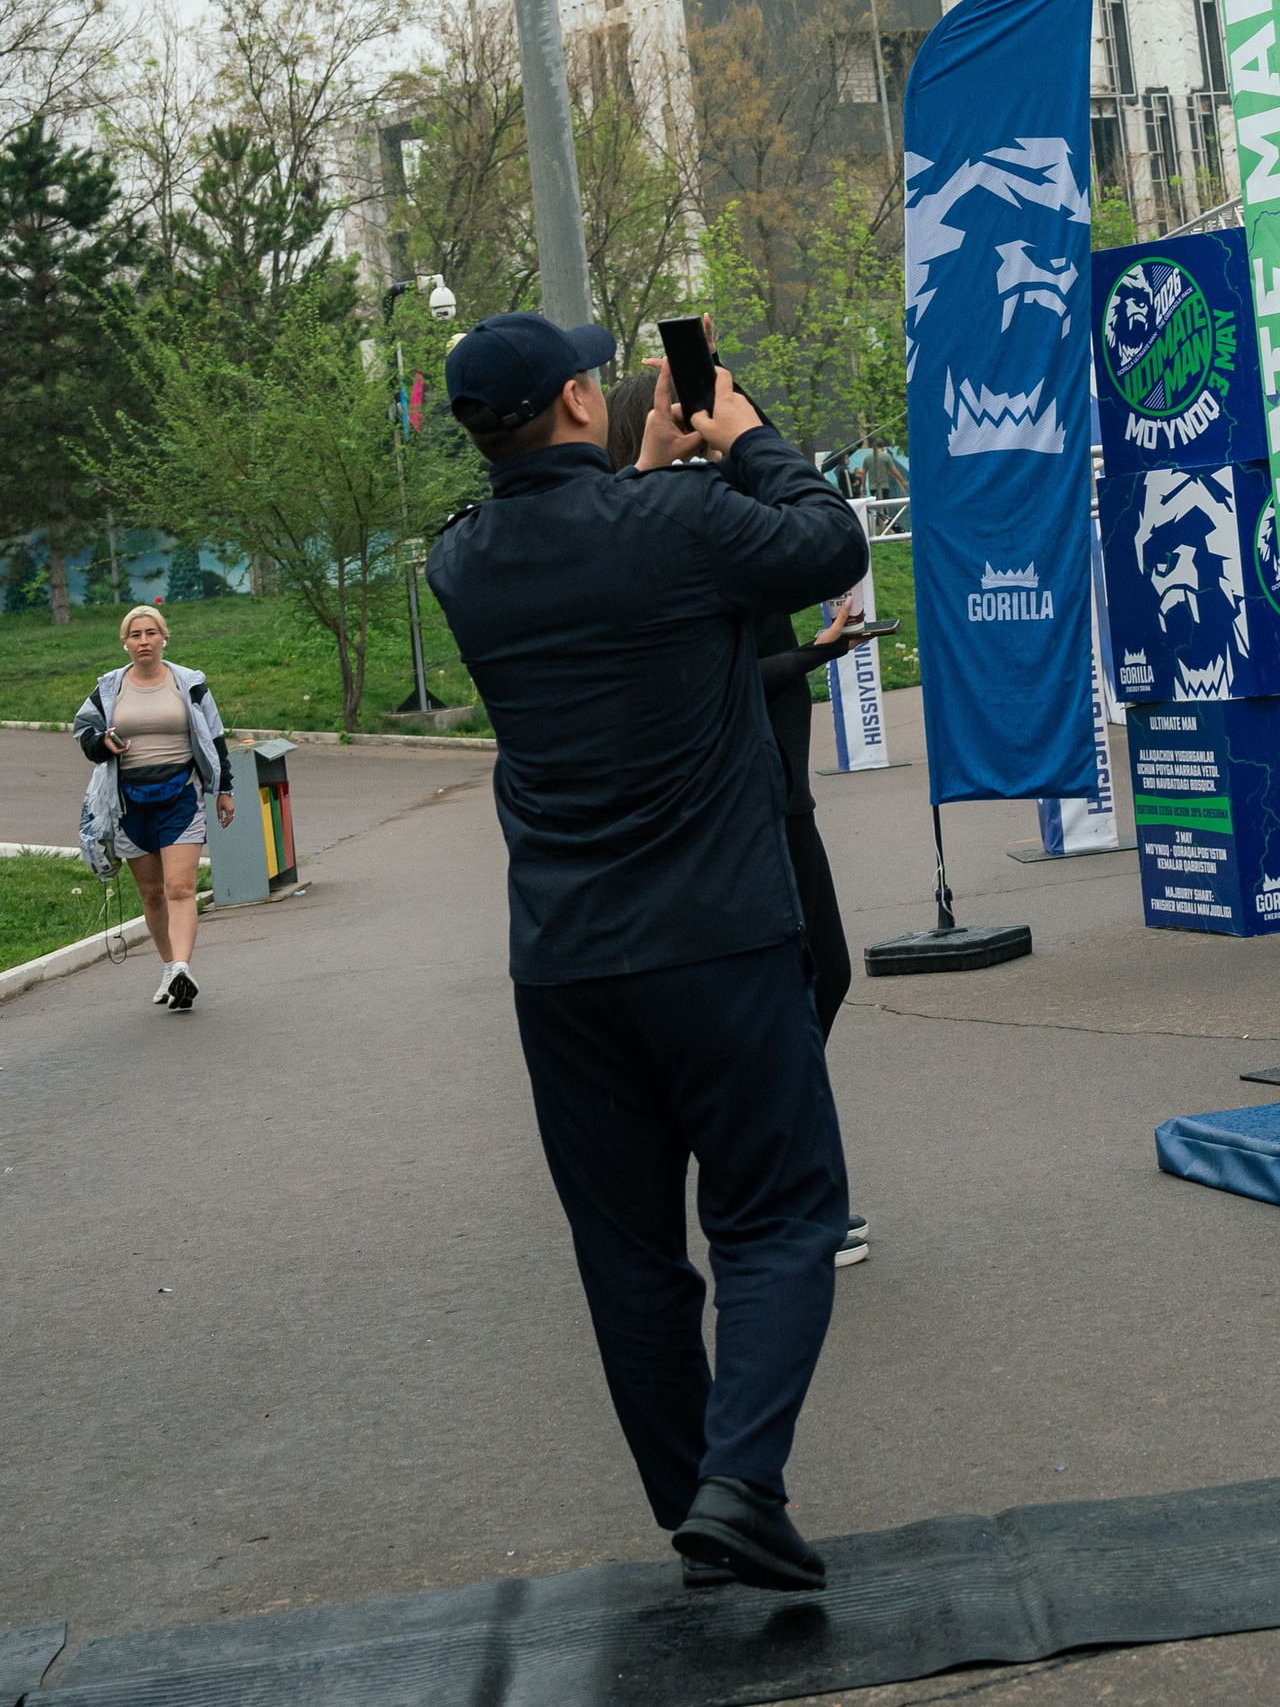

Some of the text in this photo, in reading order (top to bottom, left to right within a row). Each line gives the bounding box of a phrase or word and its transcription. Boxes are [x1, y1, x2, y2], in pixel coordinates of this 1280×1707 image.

[1153, 267, 1182, 327] 2026
[1124, 295, 1206, 404] ULTIMATE
[1163, 328, 1212, 409] MAN
[1208, 309, 1237, 397] 3 MAY
[1124, 389, 1220, 450] MO‘YNOQ
[967, 590, 1054, 622] GORILLA
[1119, 665, 1155, 684] GORILLA
[1149, 716, 1197, 731] ULTIMATE MAN
[1181, 831, 1193, 844] MAY
[1151, 898, 1176, 913] FINISHER
[1176, 900, 1197, 915] MEDALI
